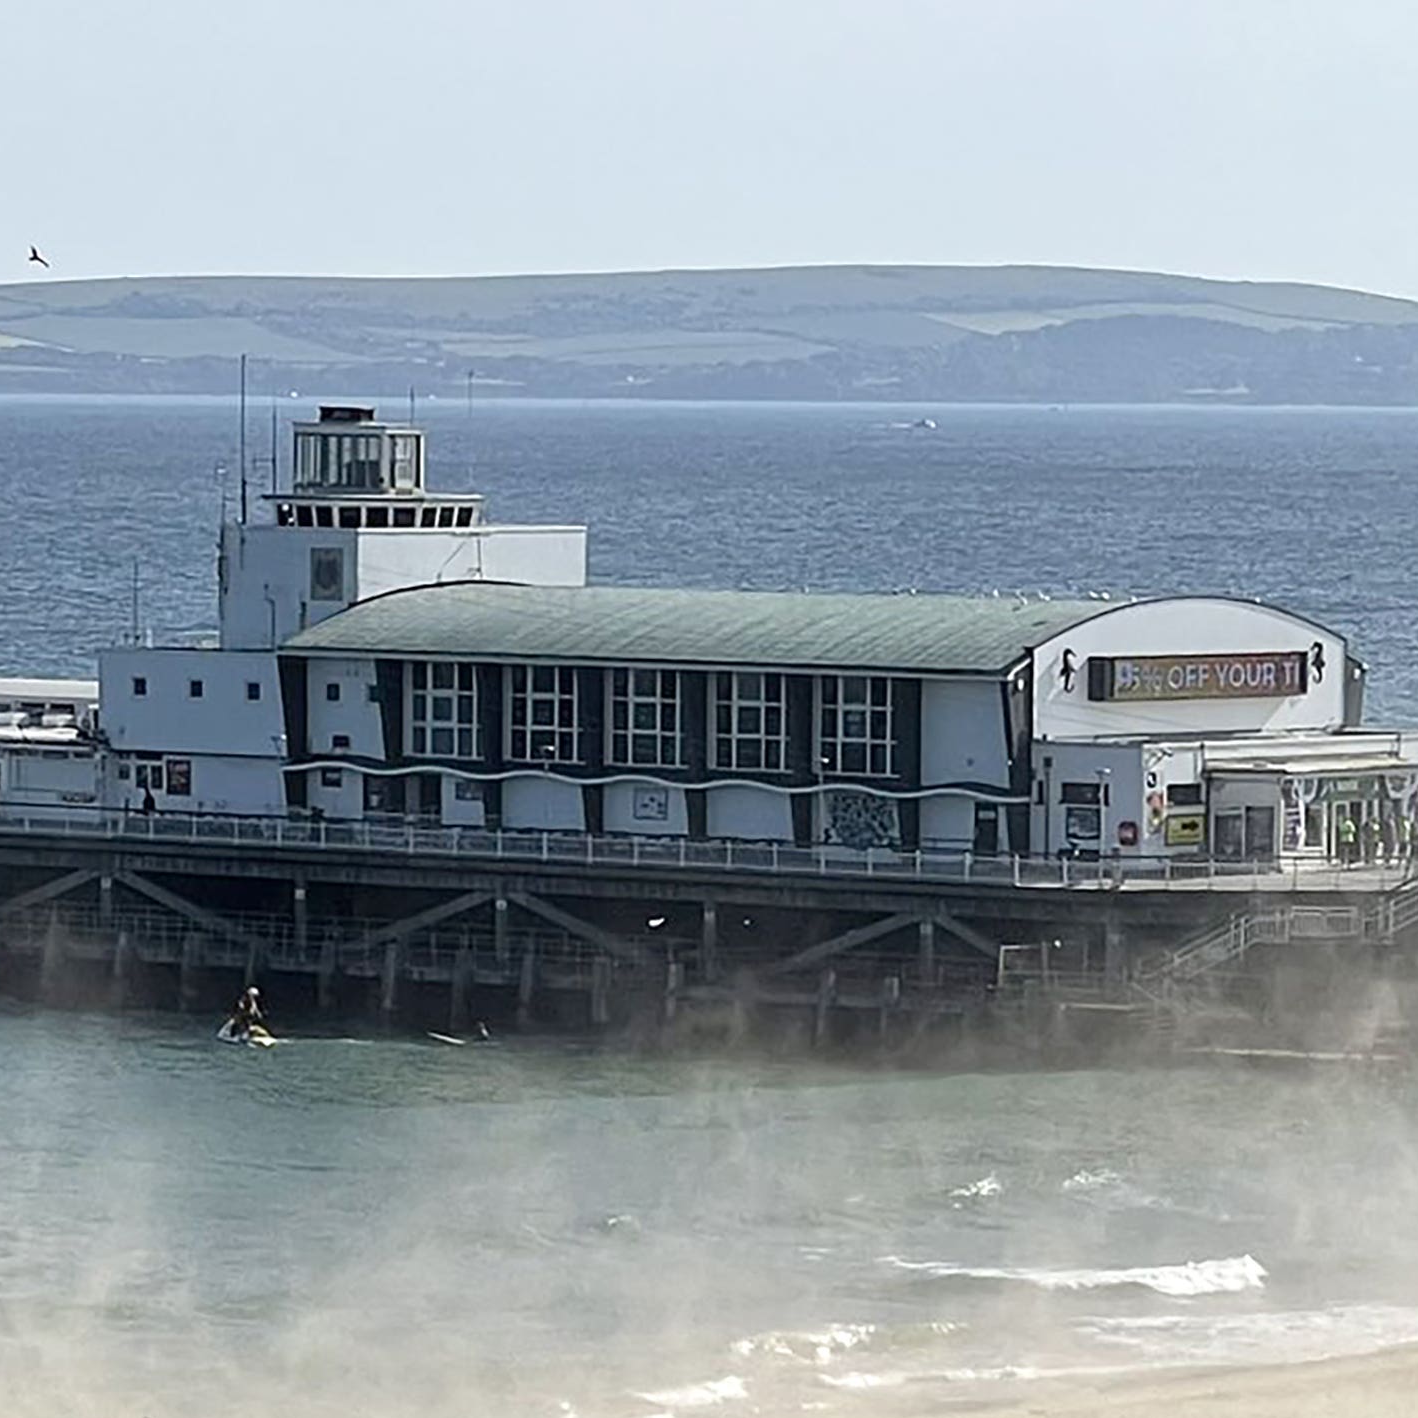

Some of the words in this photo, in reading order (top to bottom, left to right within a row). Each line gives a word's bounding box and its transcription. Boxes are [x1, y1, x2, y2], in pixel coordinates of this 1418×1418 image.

[1167, 664, 1209, 689] OFF
[1214, 663, 1276, 688] YOUR
[1282, 660, 1300, 686] TI
